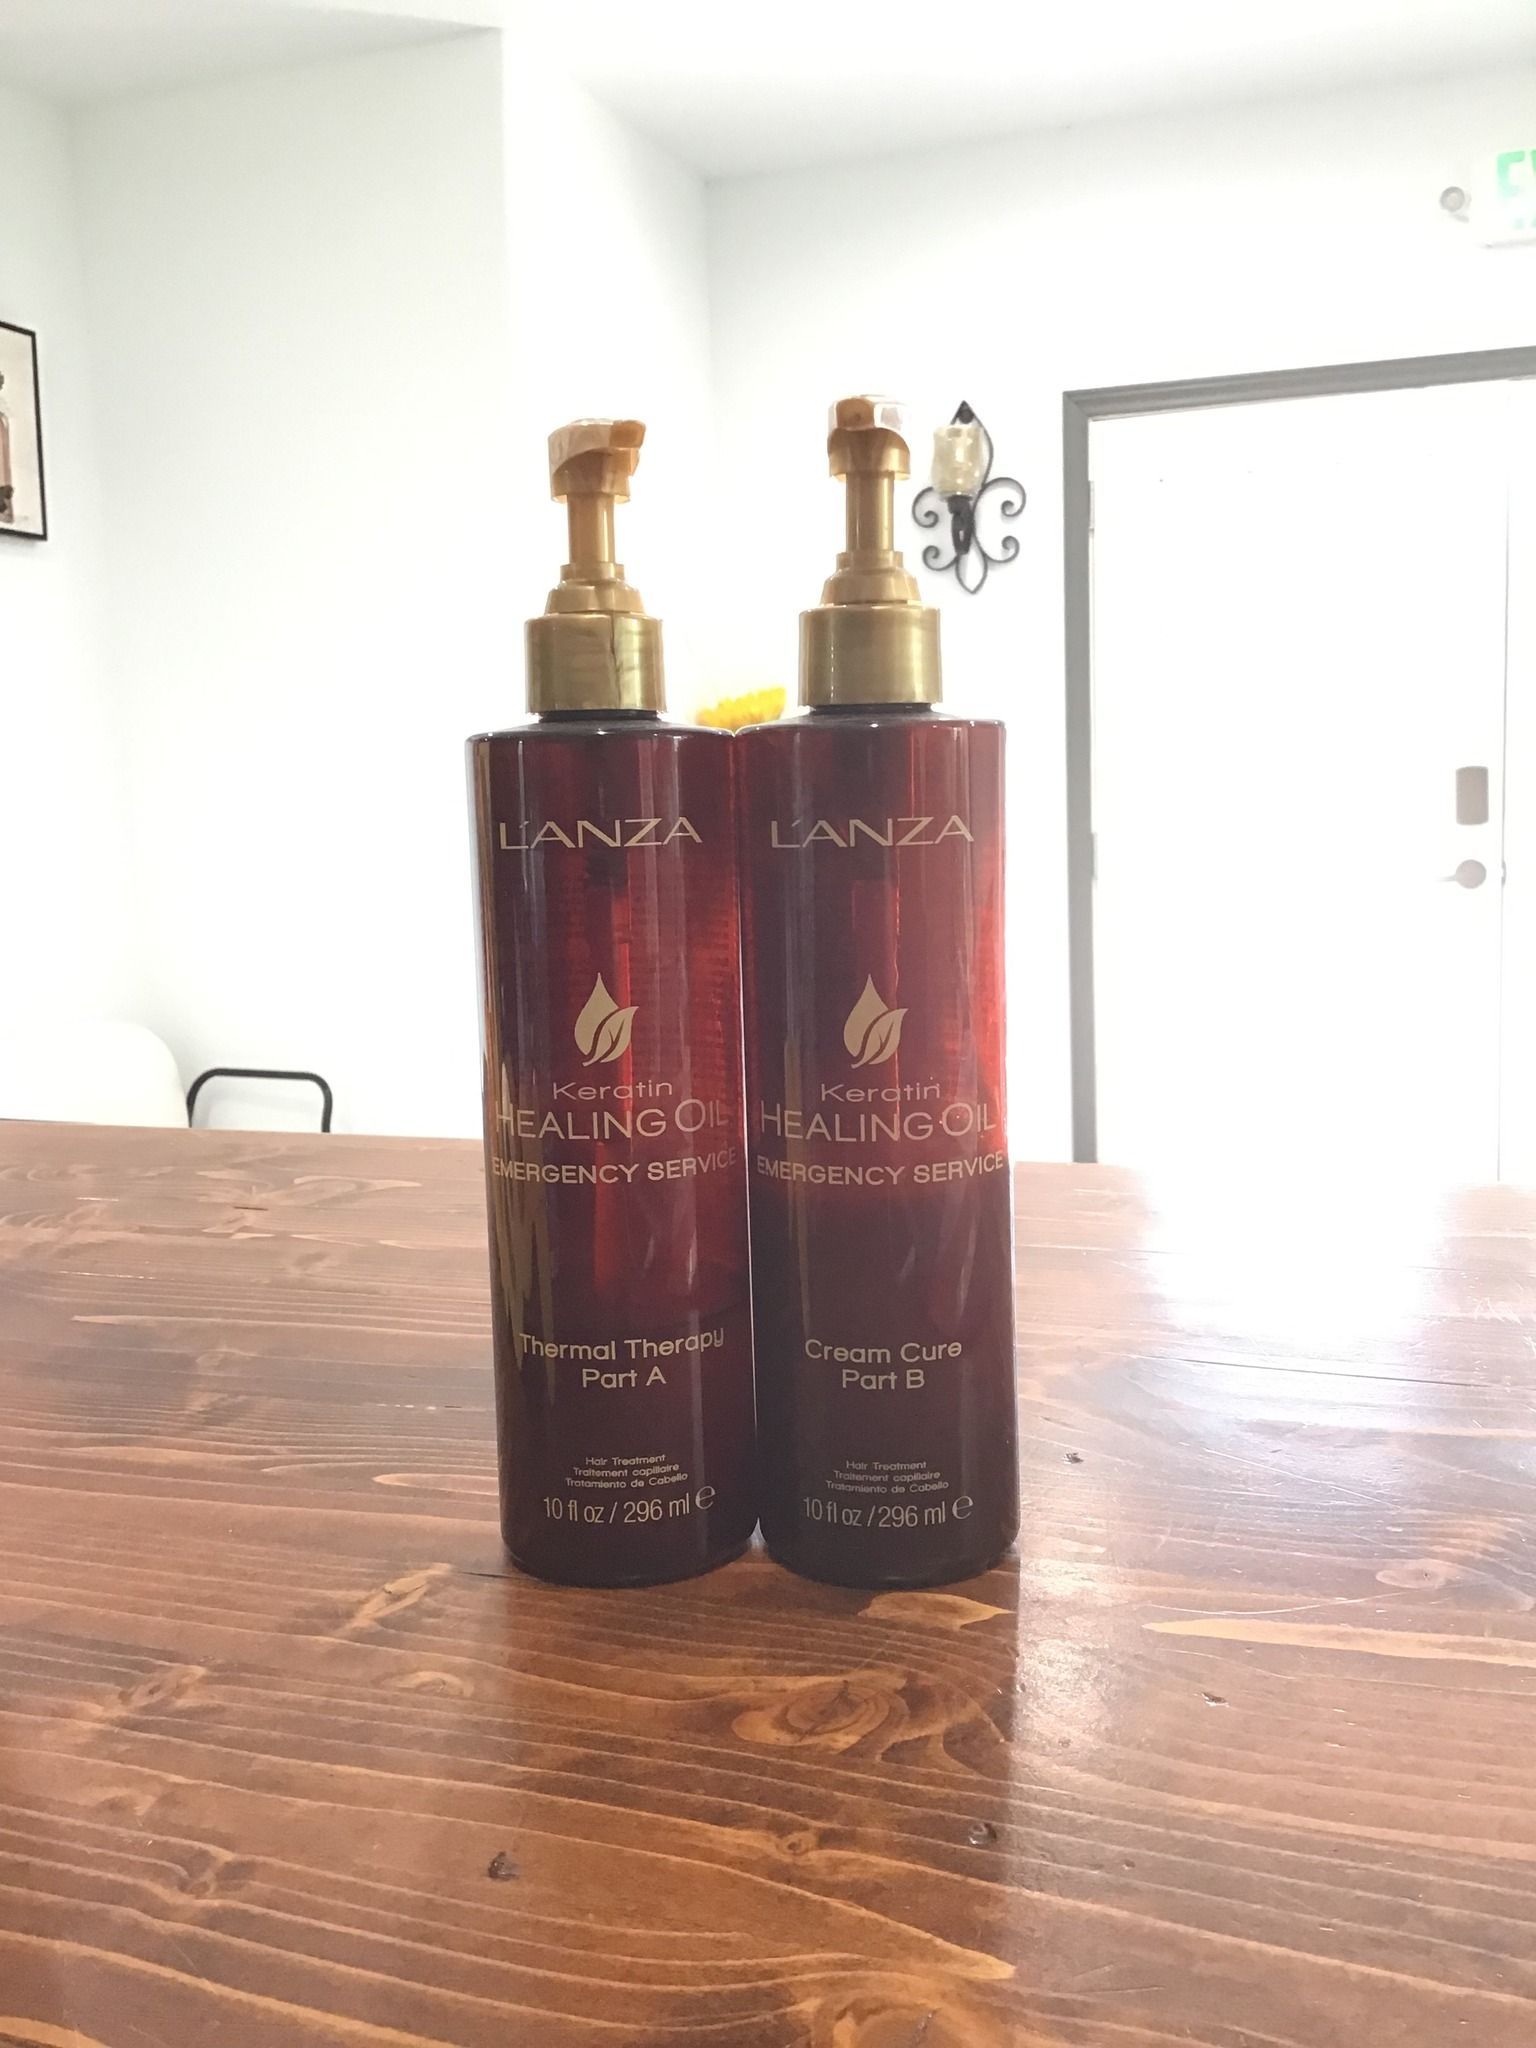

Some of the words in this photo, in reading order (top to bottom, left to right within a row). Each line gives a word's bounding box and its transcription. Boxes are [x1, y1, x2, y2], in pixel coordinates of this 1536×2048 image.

[553, 1080, 673, 1100] Keratin
[821, 1082, 940, 1102] Keratin
[491, 1157, 639, 1184] EMERGENCY
[647, 1147, 737, 1181] SERVICE
[757, 1155, 905, 1185] EMERGENCY
[913, 1151, 1003, 1183] SERVICE
[518, 1333, 616, 1360] Thermal
[623, 1327, 725, 1359] Therapy
[805, 1339, 891, 1363] Cream
[900, 1341, 962, 1363] Cure
[582, 1368, 638, 1389] Part
[646, 1366, 667, 1386] A
[842, 1369, 898, 1390] Part
[906, 1369, 925, 1389] B
[573, 1467, 628, 1477] Traitement
[632, 1463, 680, 1477] capillaire
[585, 1456, 607, 1466] Hair
[612, 1454, 666, 1466] Treatment
[846, 1460, 868, 1469] Hair
[872, 1461, 927, 1471] Treatment
[565, 1477, 626, 1489] Tratamiento
[630, 1478, 645, 1488] de
[648, 1472, 689, 1486] Cabello
[833, 1470, 889, 1482] Traitement
[892, 1471, 941, 1483] capillaire
[825, 1480, 887, 1494] Tratamiento
[891, 1483, 906, 1493] de
[909, 1481, 949, 1493] Cabello
[543, 1497, 563, 1519] 10
[568, 1499, 578, 1522] fl
[584, 1505, 605, 1523] oz
[623, 1499, 663, 1523] 296
[669, 1493, 690, 1517] ml
[803, 1497, 823, 1520] 10
[826, 1501, 837, 1523] fl
[842, 1507, 862, 1526] oz
[878, 1505, 918, 1528] 296
[924, 1501, 946, 1526] ml
